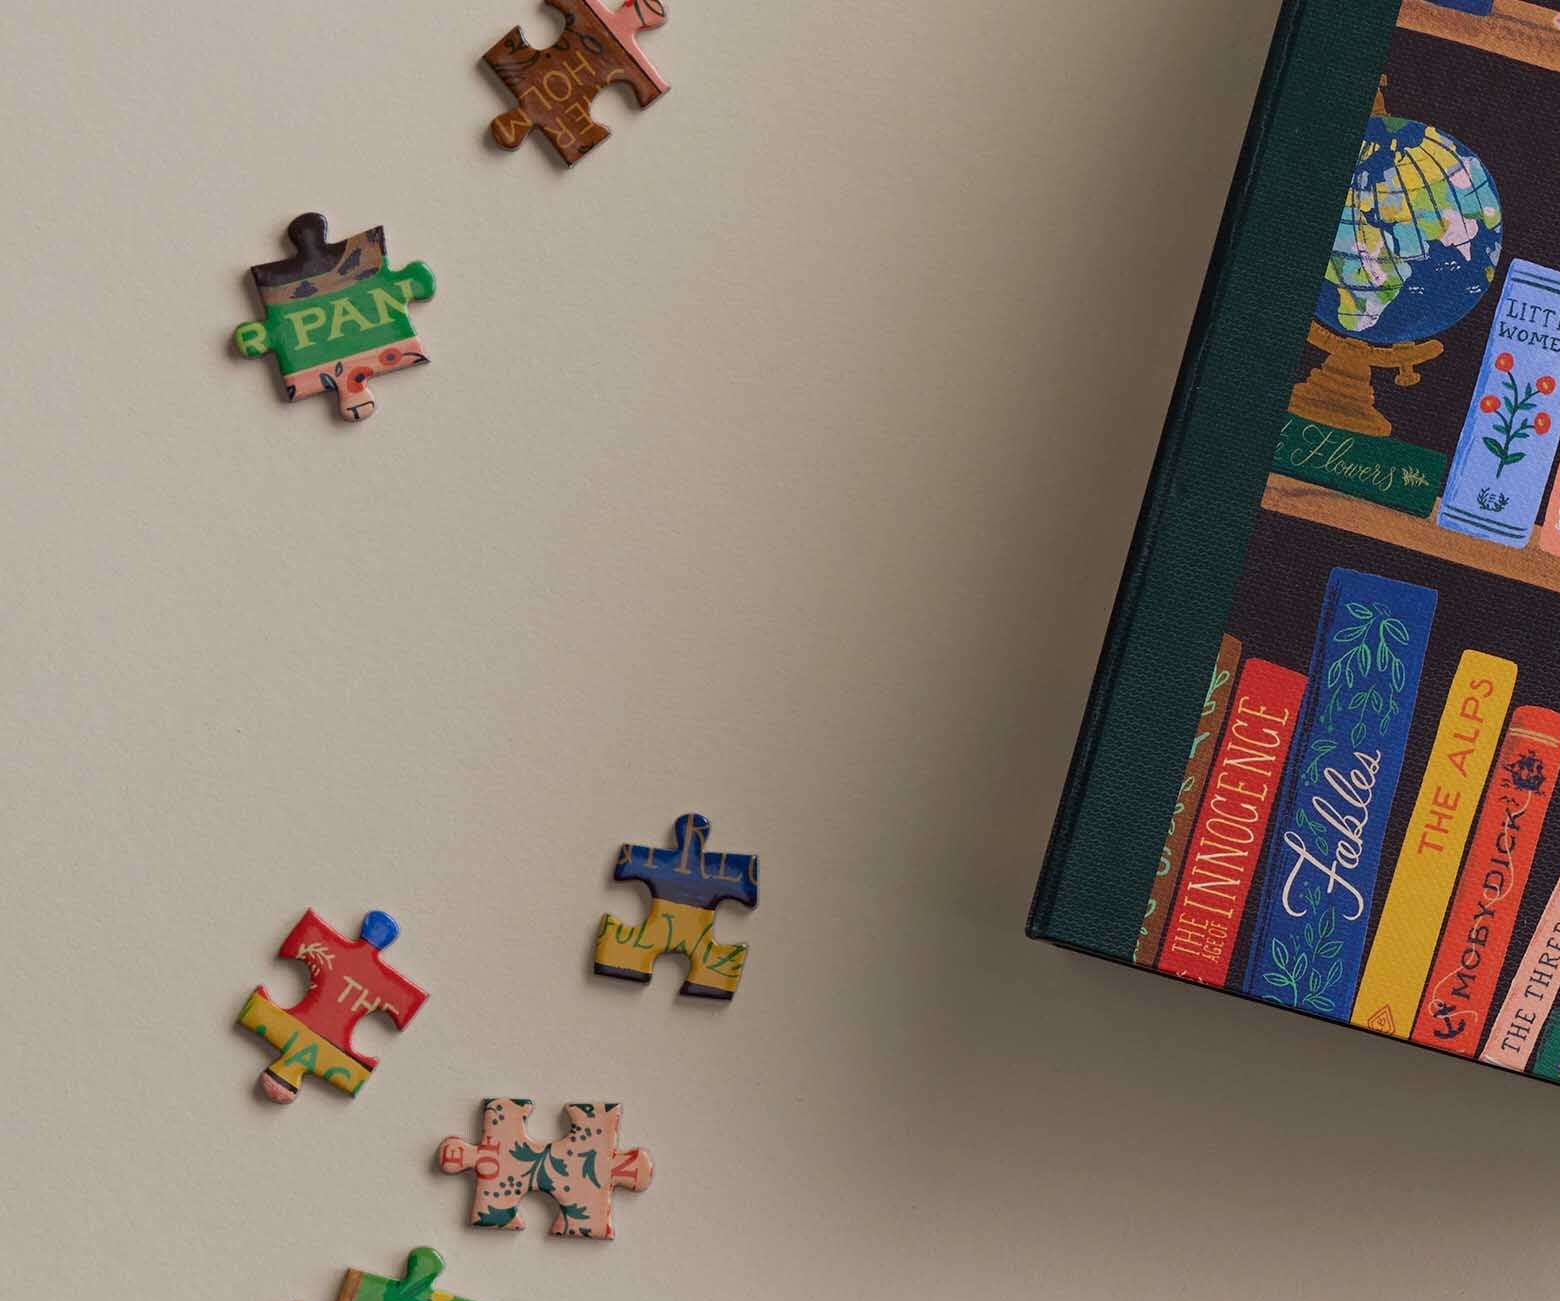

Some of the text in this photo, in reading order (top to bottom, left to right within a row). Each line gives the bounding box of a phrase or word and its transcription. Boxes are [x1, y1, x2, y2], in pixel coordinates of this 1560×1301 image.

[284, 278, 414, 351] PAN
[1290, 424, 1397, 492] Flowers
[1184, 696, 1289, 919] INNOCENCE
[1417, 678, 1495, 859] THE ALPS
[1282, 749, 1381, 921] Fables
[1171, 910, 1210, 956] THE
[1450, 804, 1523, 1000] MOBY DICK
[1501, 1007, 1536, 1056] THE
